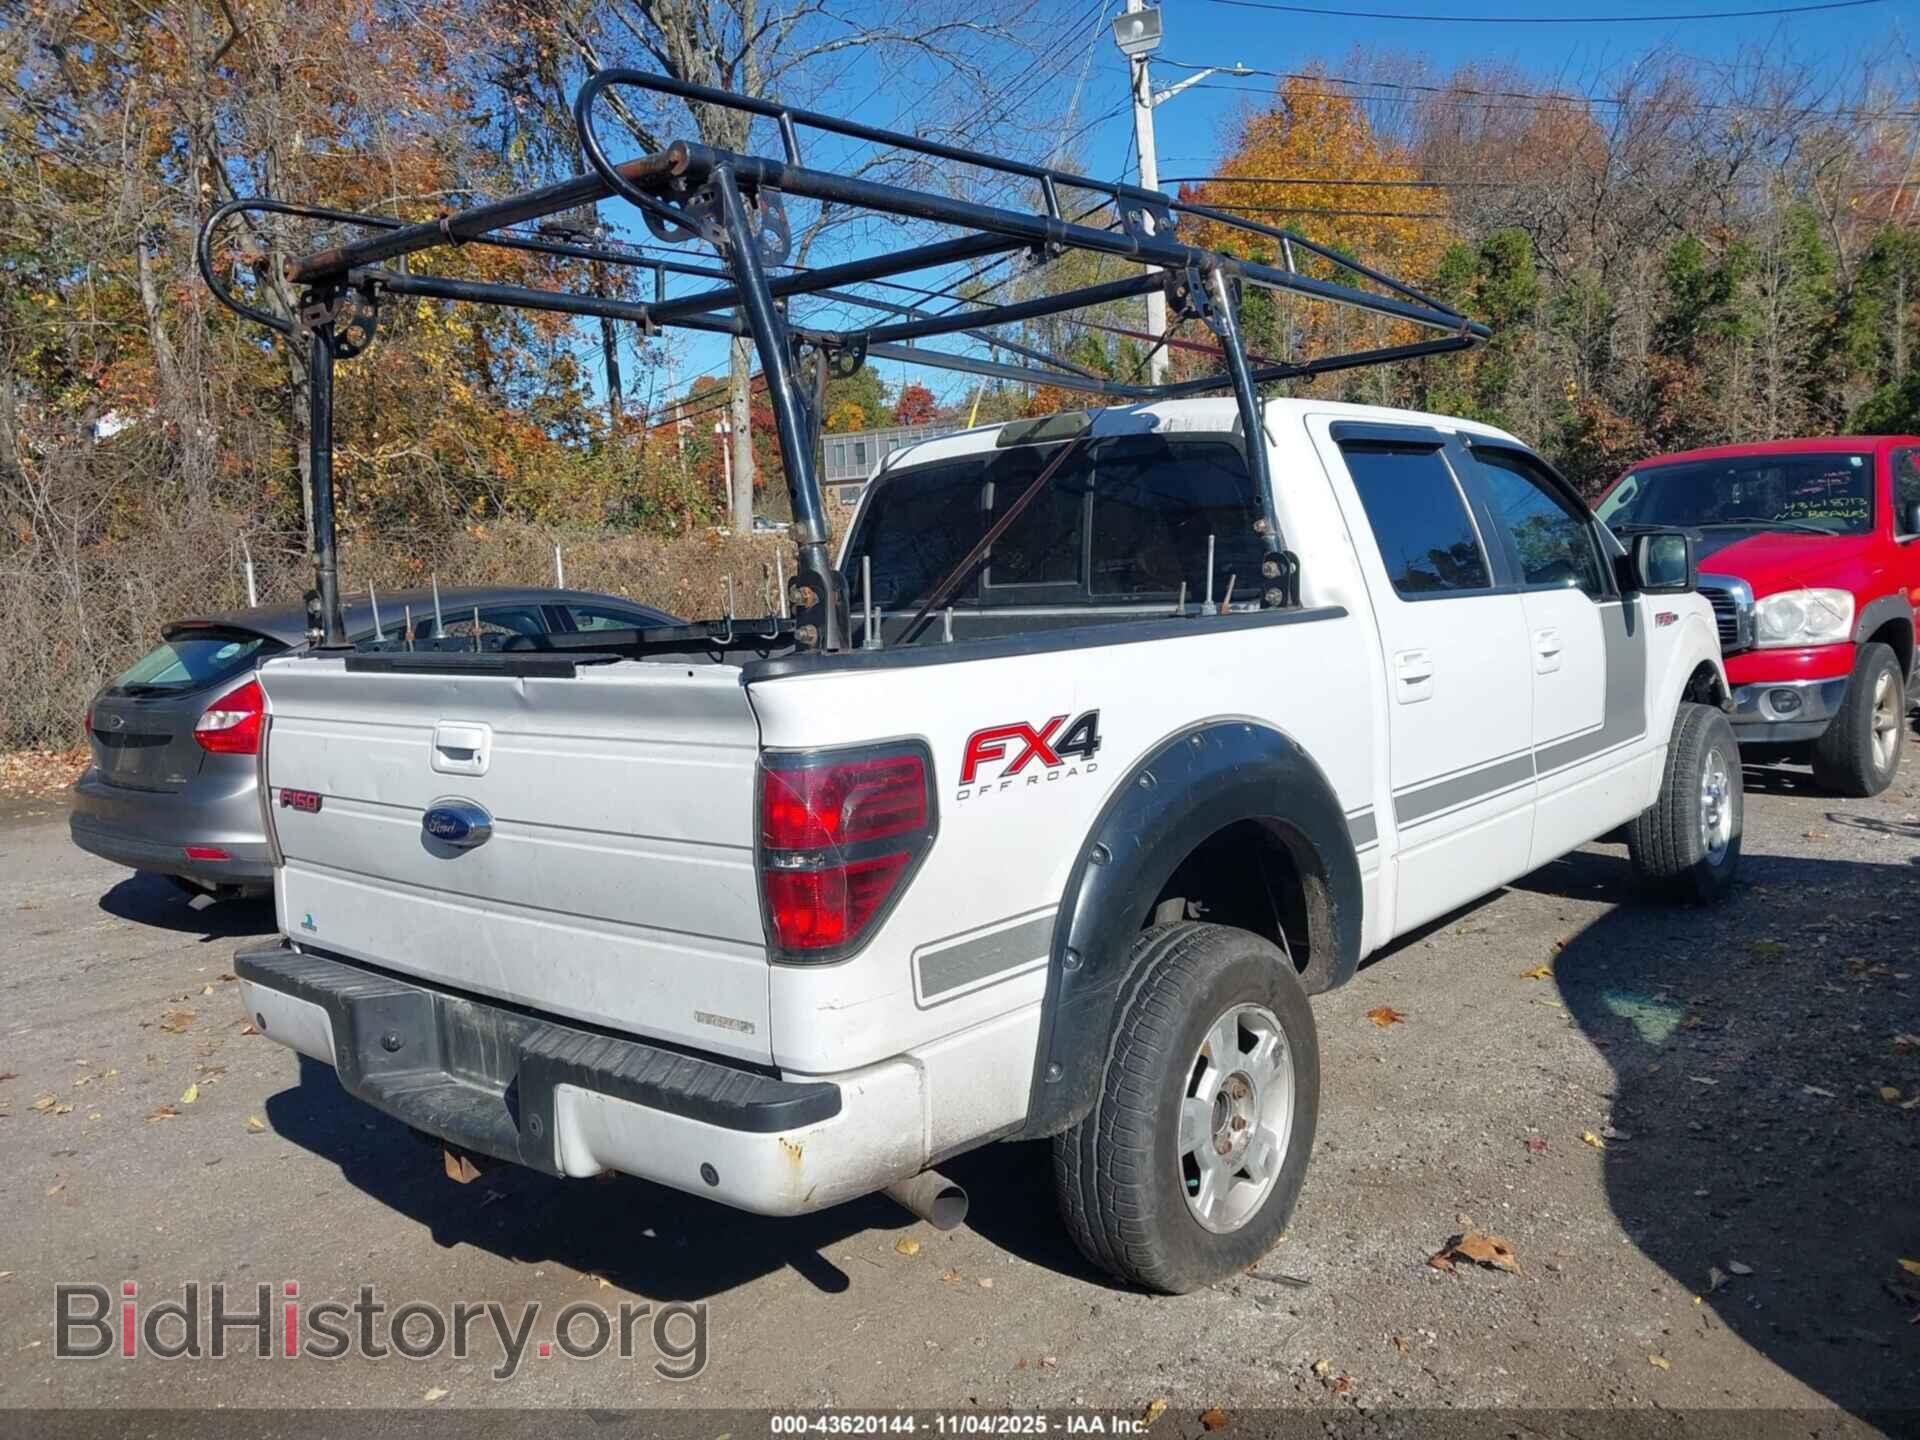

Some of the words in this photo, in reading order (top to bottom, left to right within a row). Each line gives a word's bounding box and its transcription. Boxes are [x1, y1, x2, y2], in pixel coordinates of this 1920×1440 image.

[958, 709, 1102, 786] FX4
[956, 780, 1012, 801] OFF
[1027, 763, 1098, 786] ROAD
[428, 815, 457, 833] Ford
